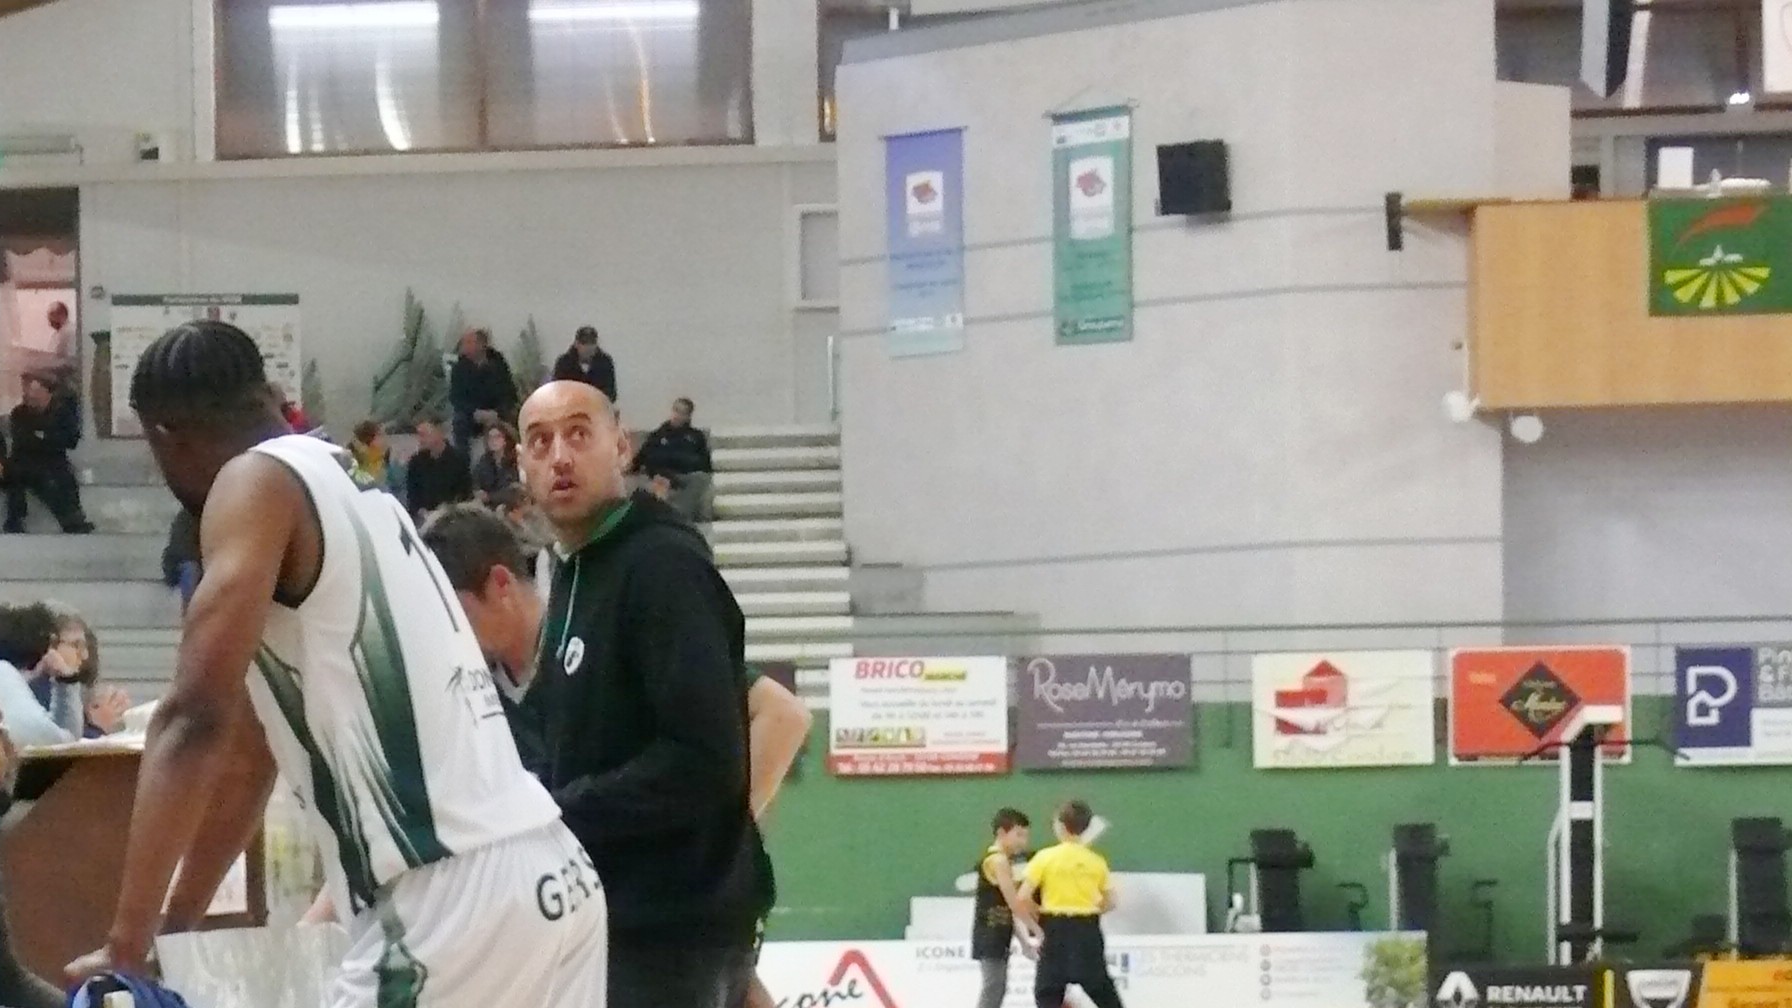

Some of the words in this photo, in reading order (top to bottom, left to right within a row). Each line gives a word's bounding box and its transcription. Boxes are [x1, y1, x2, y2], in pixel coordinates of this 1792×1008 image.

[855, 659, 925, 680] BRICO
[916, 946, 966, 959] ICONE
[1486, 985, 1587, 1003] RENAULT
